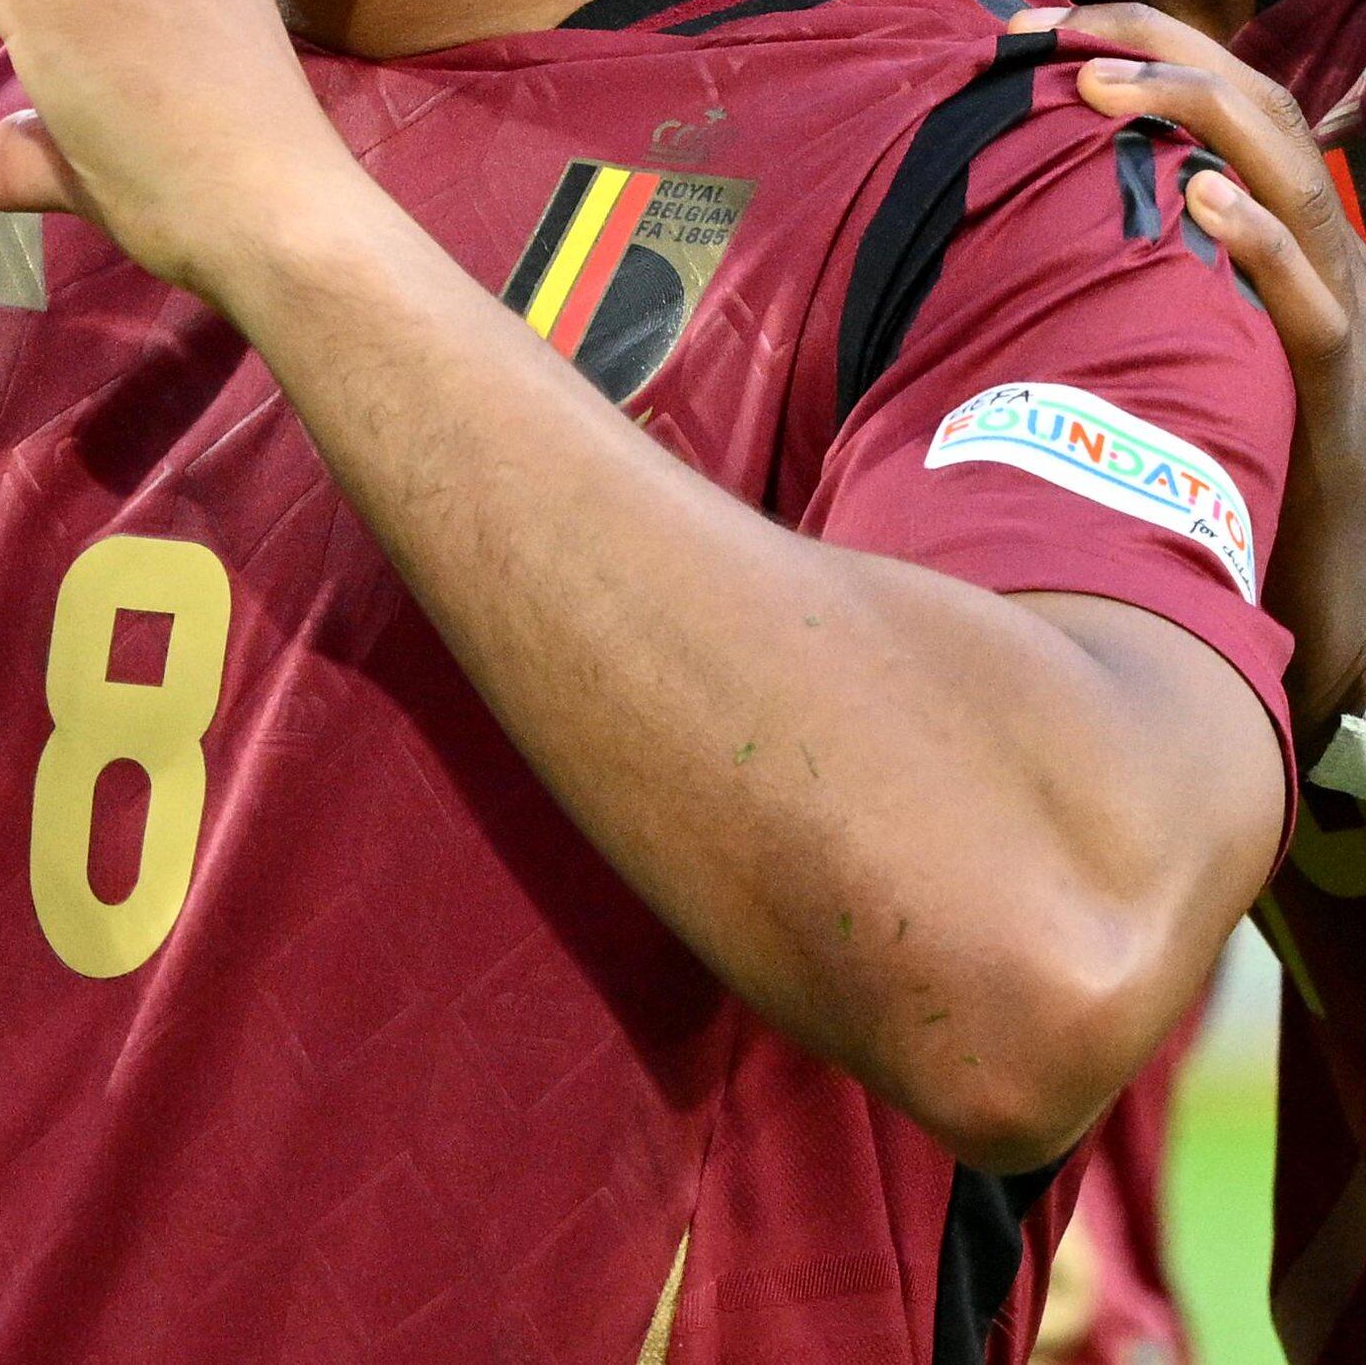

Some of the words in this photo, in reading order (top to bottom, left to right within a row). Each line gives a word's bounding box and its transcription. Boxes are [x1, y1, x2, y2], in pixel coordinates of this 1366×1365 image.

[657, 179, 724, 203] ROYAL
[645, 200, 738, 225] BELGIAN
[29, 534, 232, 979] 8
